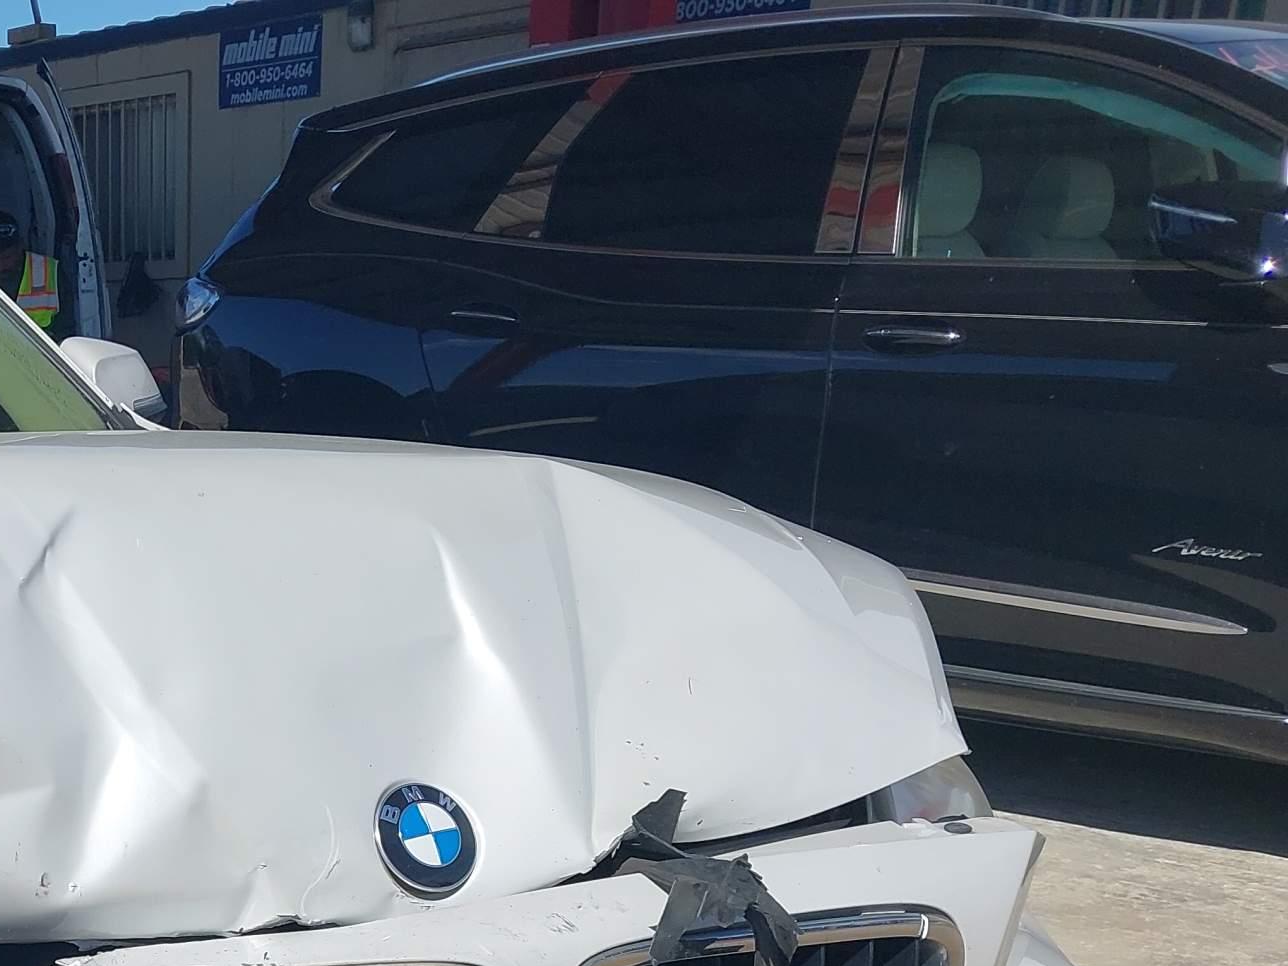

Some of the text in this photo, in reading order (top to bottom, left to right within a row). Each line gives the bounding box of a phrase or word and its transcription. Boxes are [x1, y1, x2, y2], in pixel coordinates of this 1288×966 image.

[223, 24, 320, 65] mobile mini
[226, 62, 313, 87] 1-800-950-6464
[230, 84, 308, 104] mobilemini.com
[1151, 538, 1263, 560] Avenir
[380, 785, 457, 824] BMW
